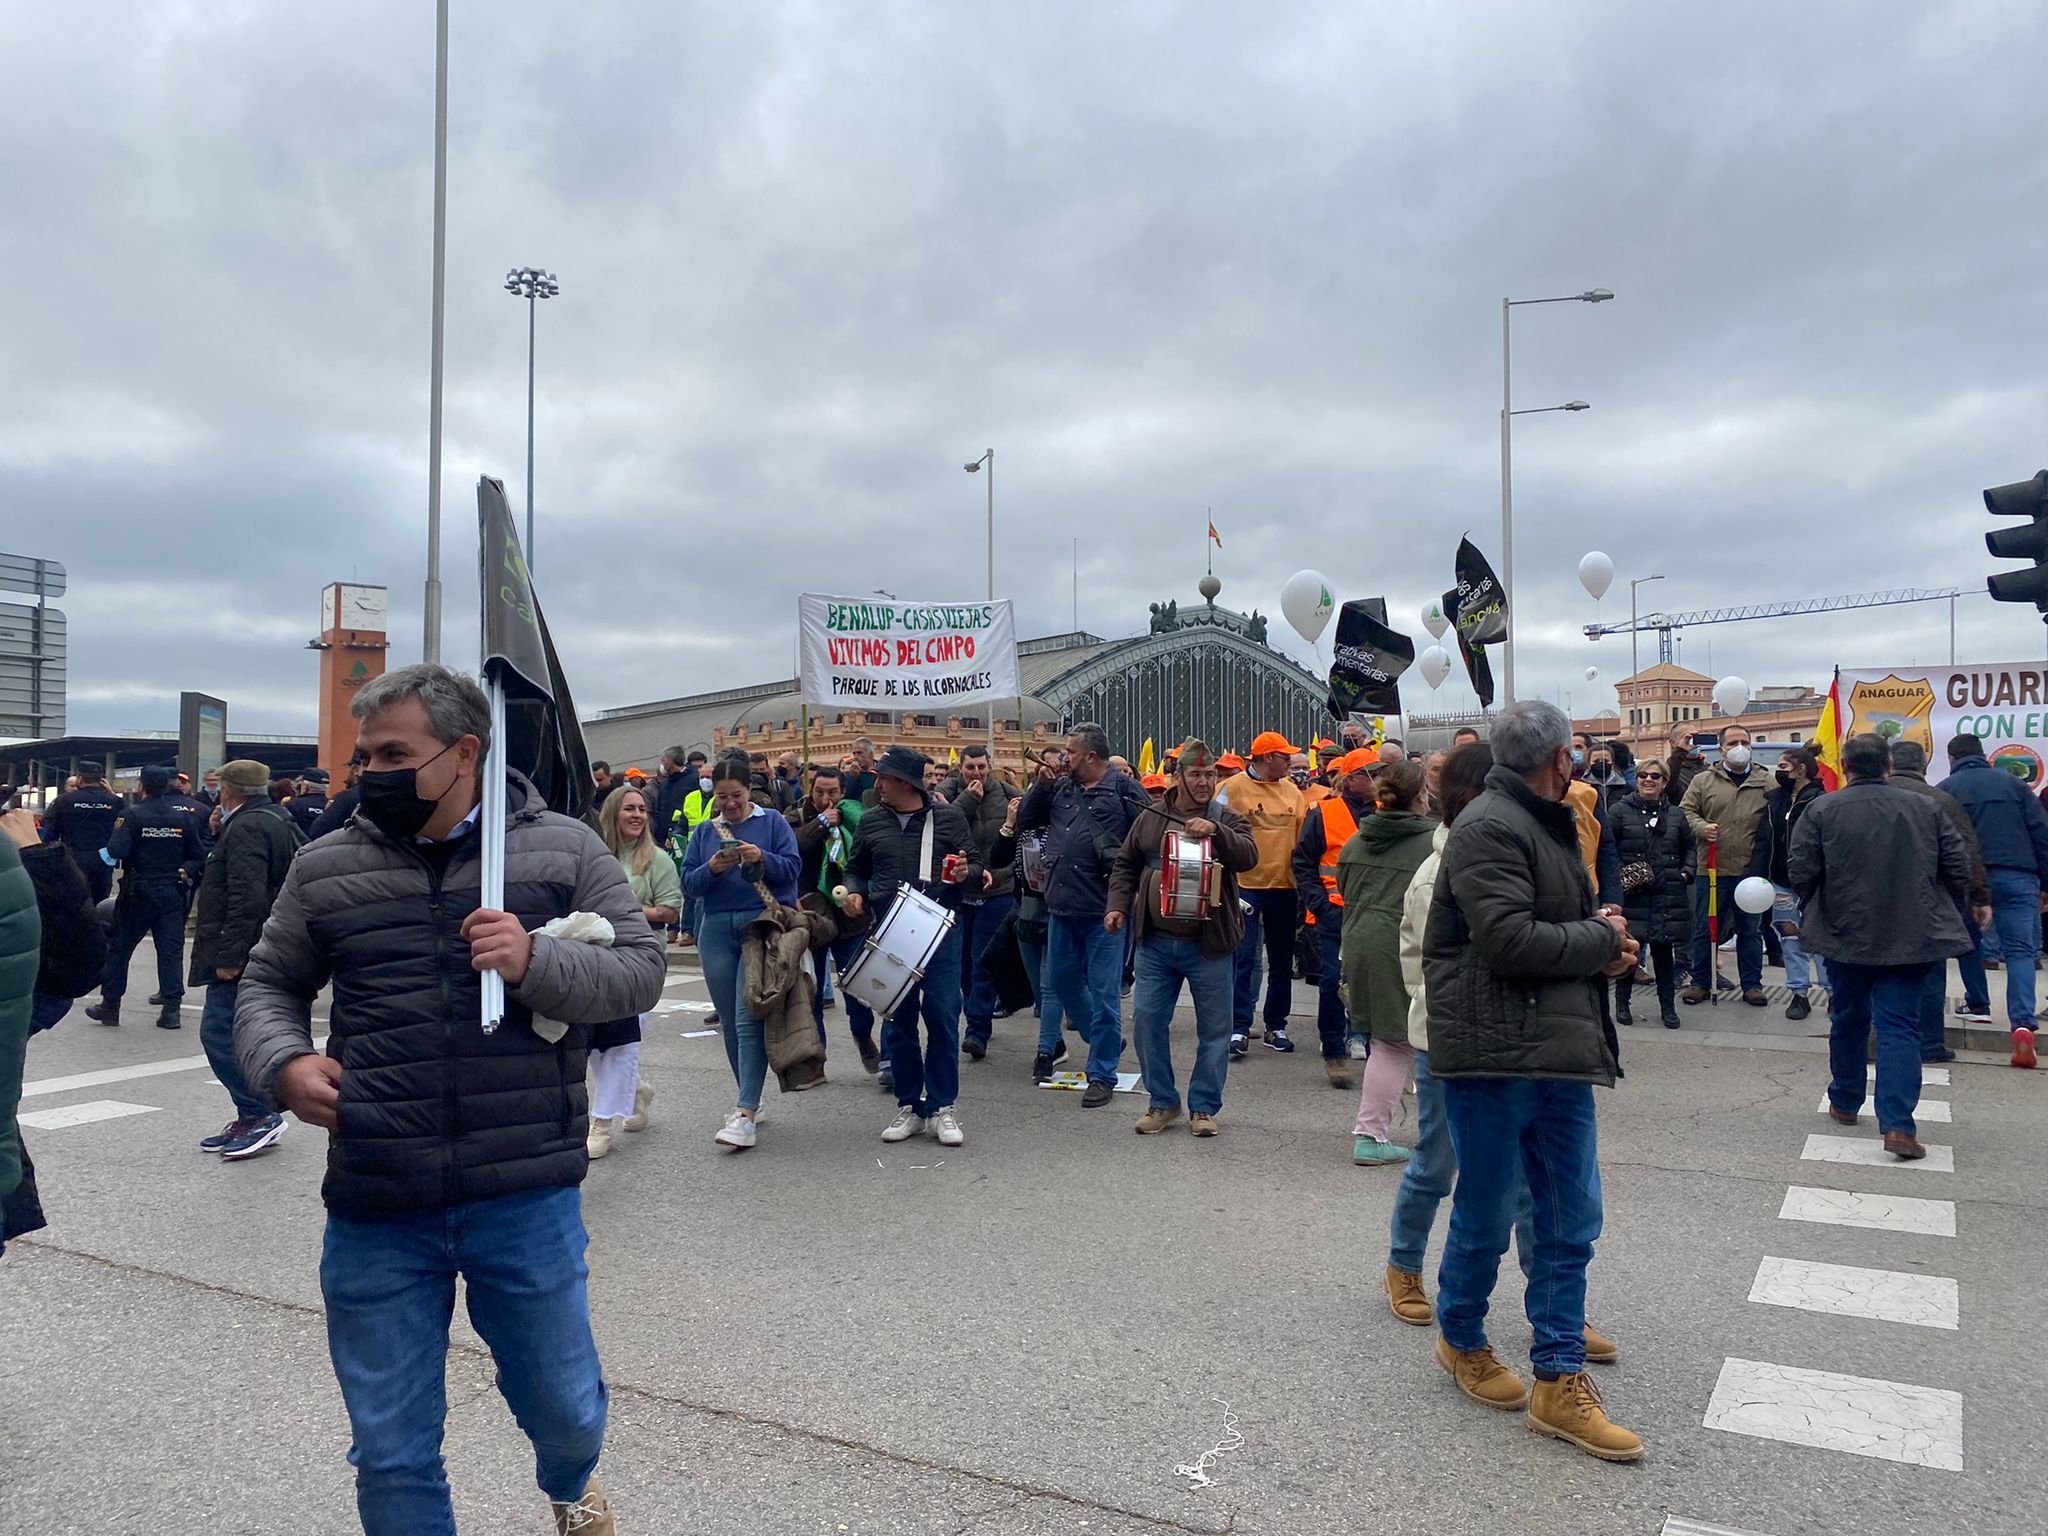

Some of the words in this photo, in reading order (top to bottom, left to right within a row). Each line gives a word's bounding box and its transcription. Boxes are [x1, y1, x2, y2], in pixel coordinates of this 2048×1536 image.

[827, 638, 891, 666] VIVIMOS
[896, 639, 922, 666] DEL
[925, 635, 975, 664] CAMPO
[832, 676, 879, 696] PARQUE
[885, 679, 898, 696] DE
[902, 680, 920, 697] LOS
[924, 672, 992, 697] ALCORNOCALES
[1859, 688, 1925, 699] ANAGUAR
[1956, 714, 2015, 739] CON
